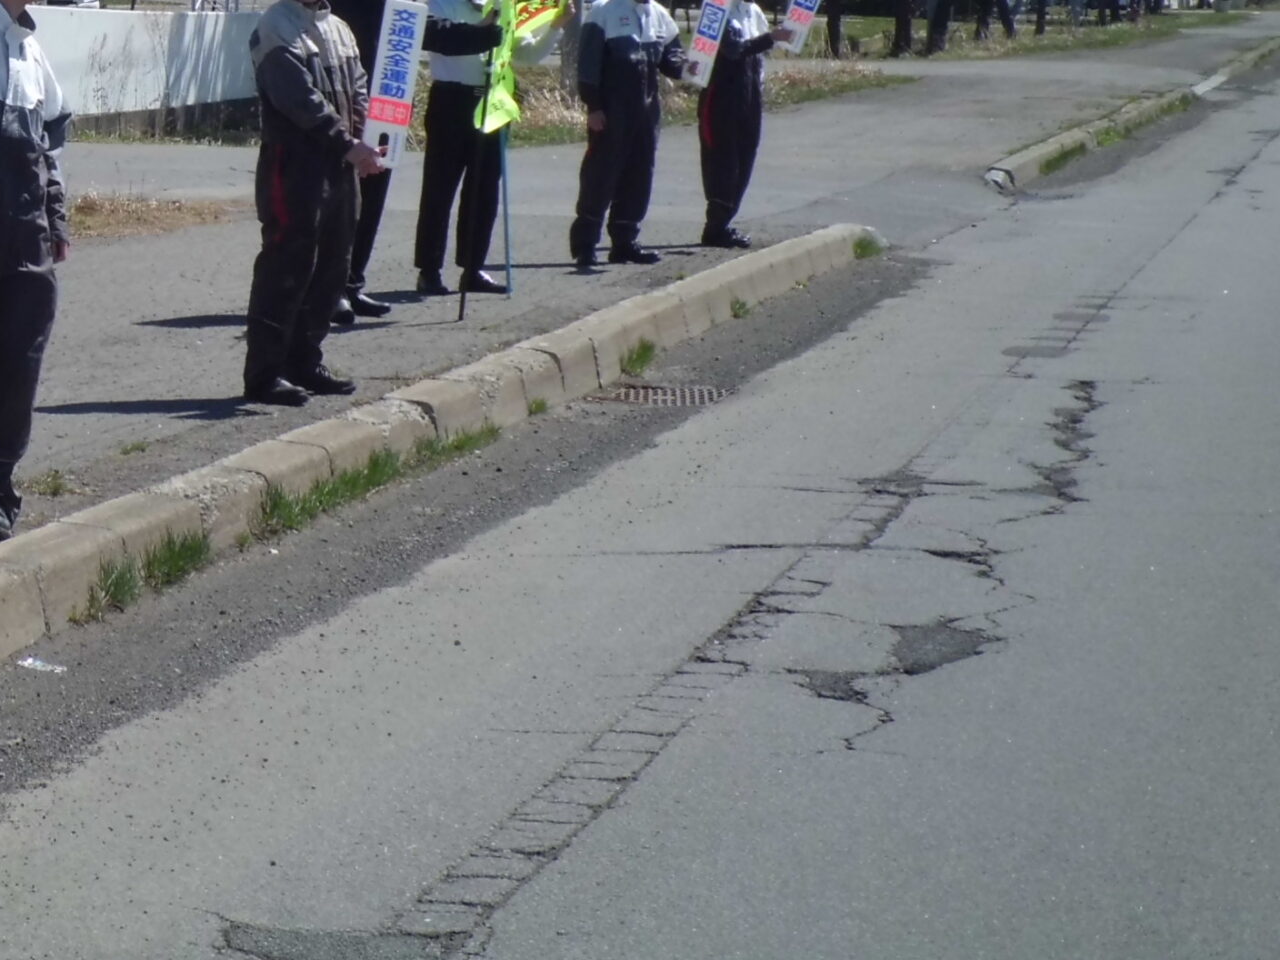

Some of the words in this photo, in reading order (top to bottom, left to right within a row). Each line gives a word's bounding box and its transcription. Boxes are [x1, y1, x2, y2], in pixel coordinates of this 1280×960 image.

[378, 8, 418, 100] 交通安全運動
